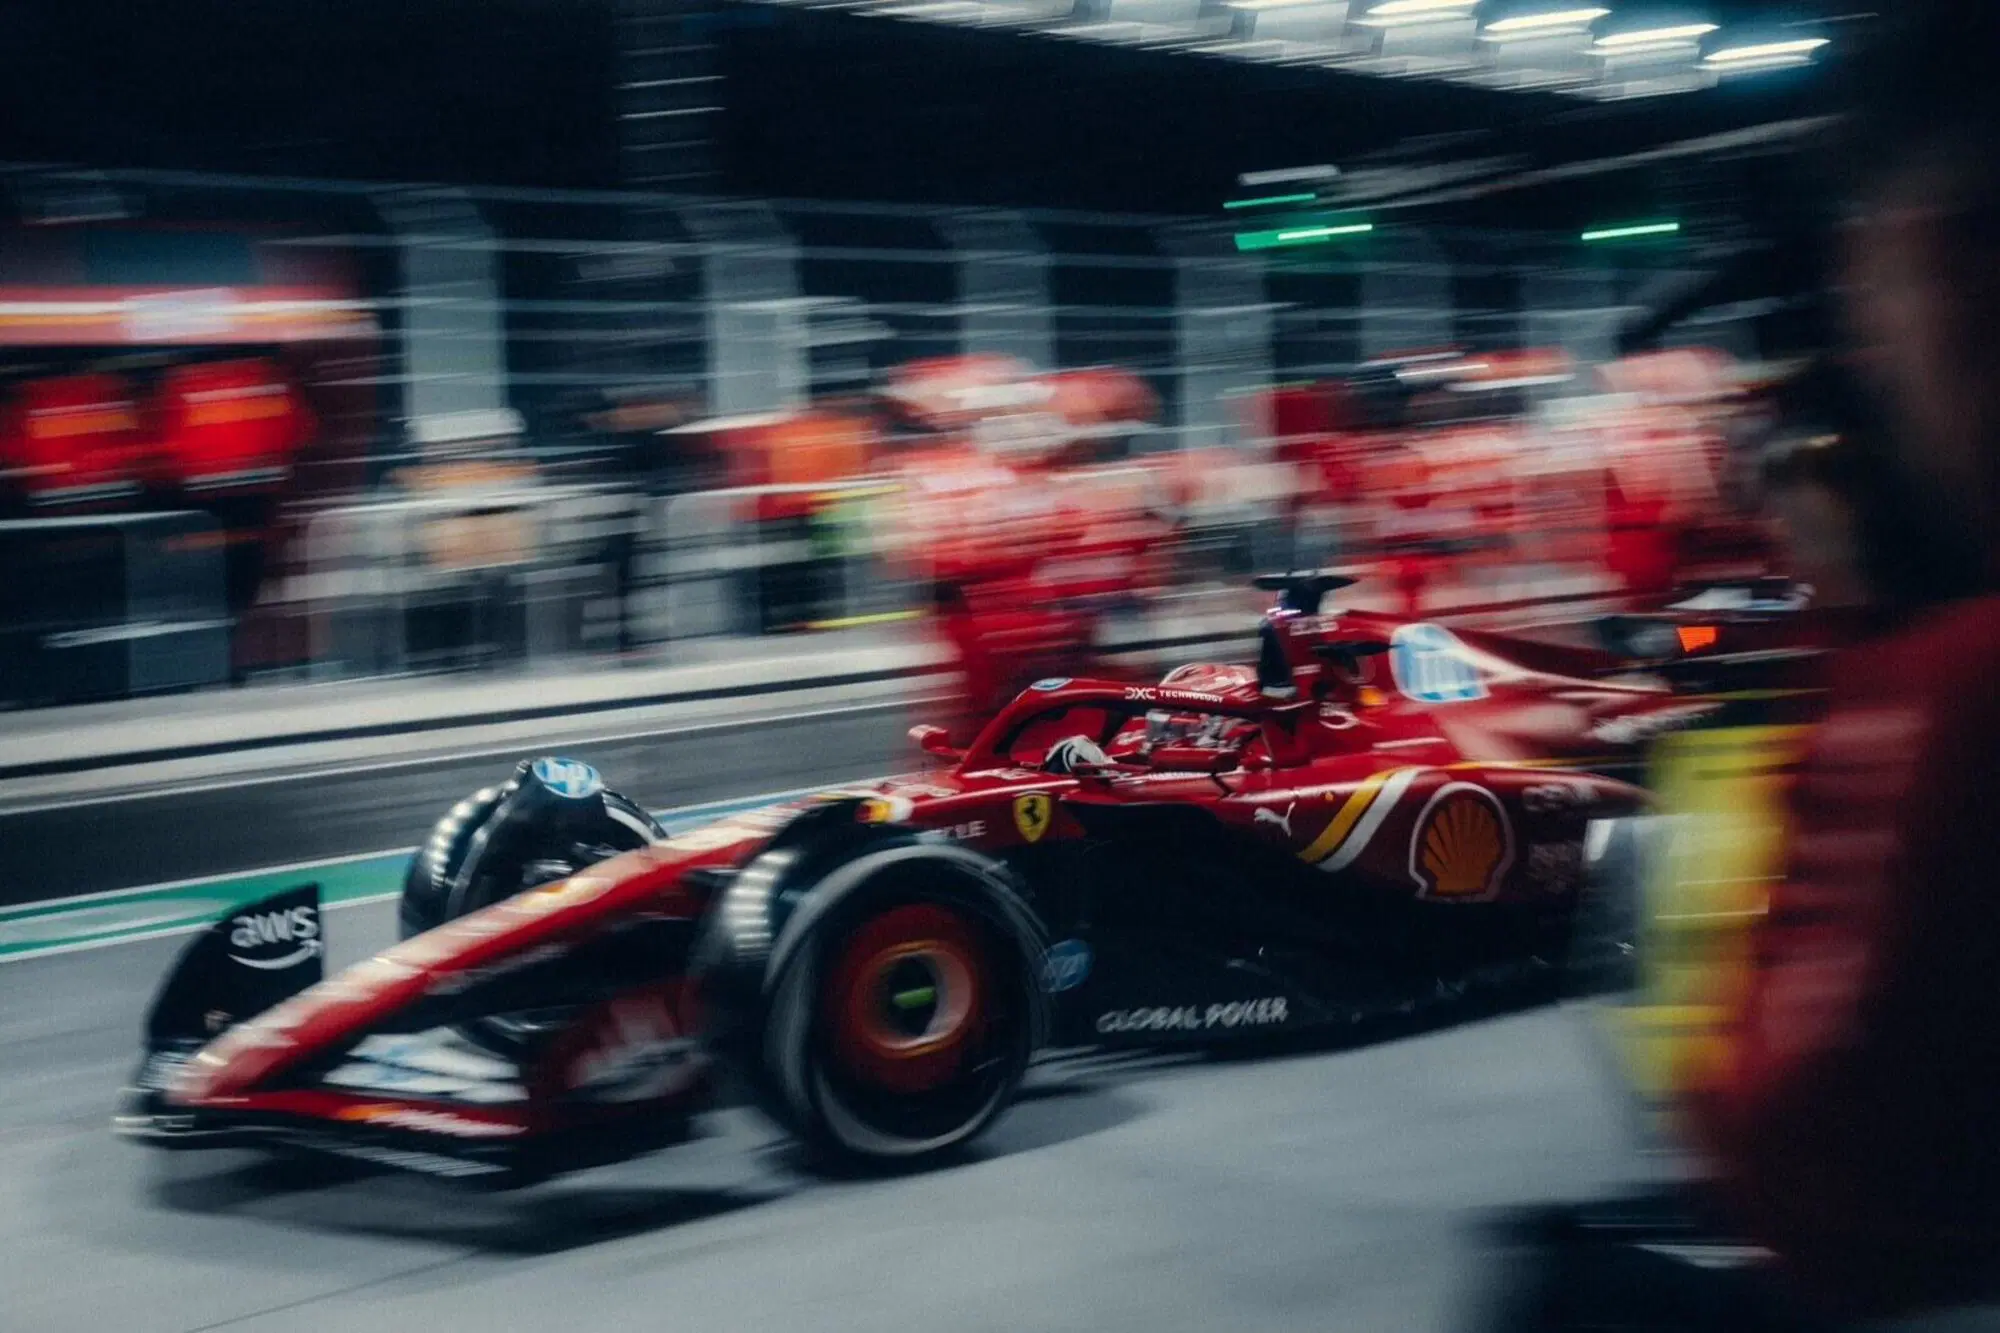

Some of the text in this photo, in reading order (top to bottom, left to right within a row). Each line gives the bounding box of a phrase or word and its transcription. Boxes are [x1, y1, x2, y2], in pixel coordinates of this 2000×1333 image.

[1124, 687, 1223, 702] DXC TECHNOLOGY
[231, 906, 318, 948] aws
[1096, 997, 1289, 1033] GLOBAL POKER
